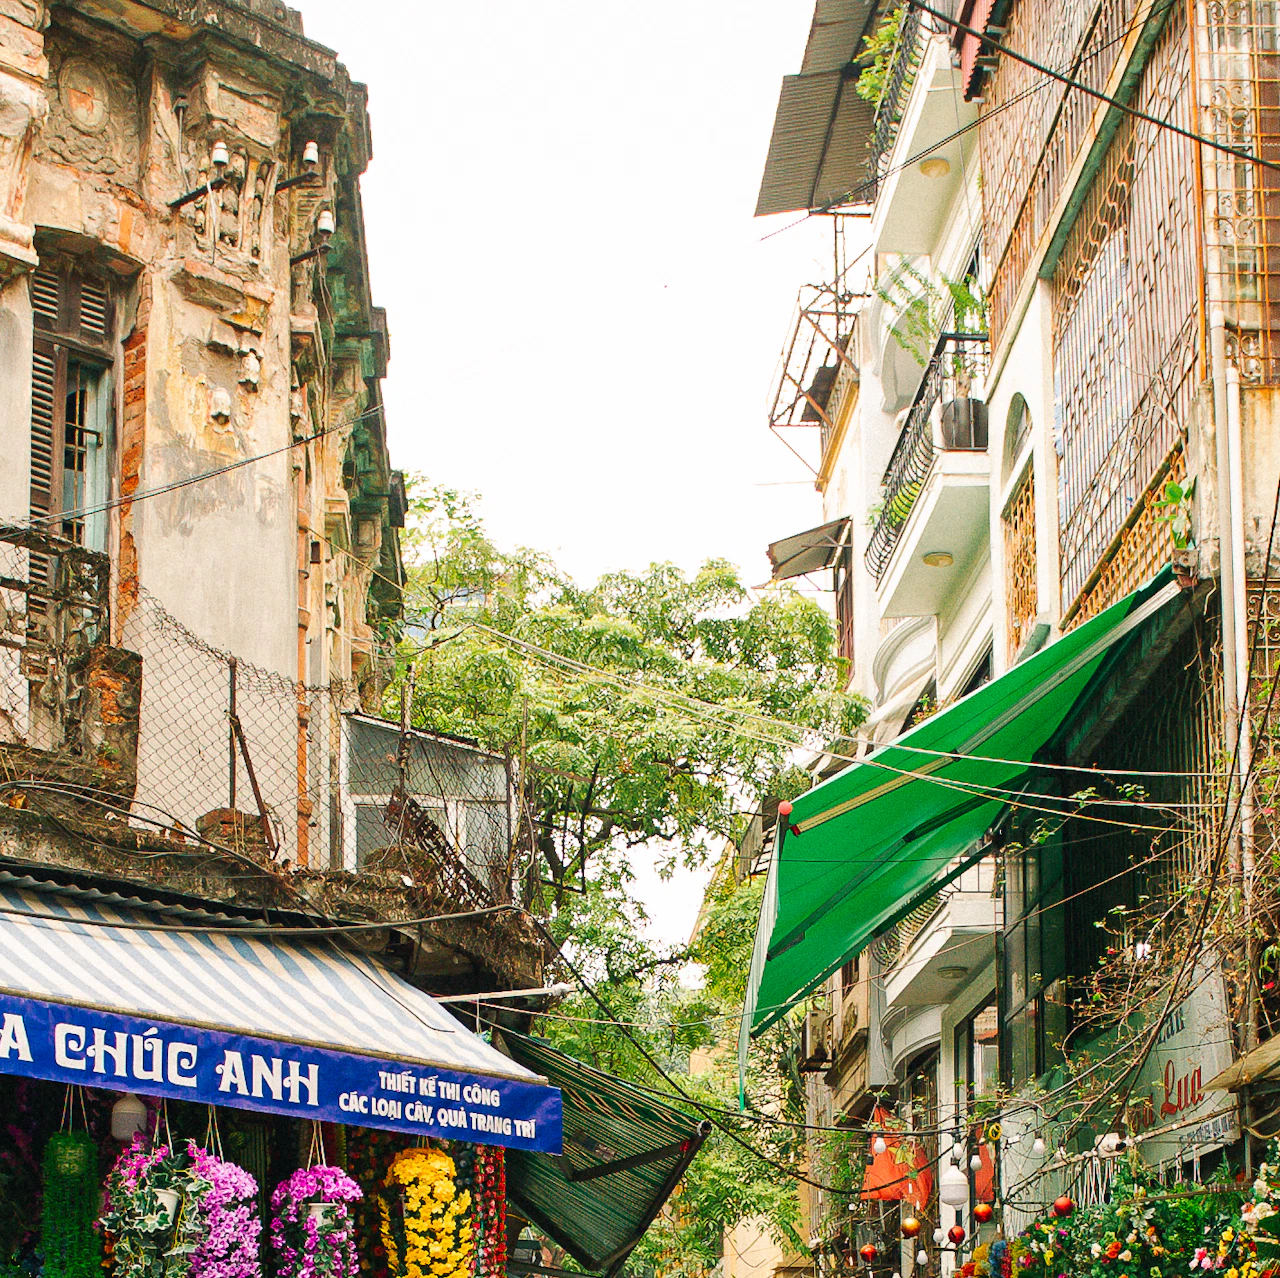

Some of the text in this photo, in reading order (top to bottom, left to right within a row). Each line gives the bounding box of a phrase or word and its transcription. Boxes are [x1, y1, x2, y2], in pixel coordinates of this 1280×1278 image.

[54, 1023, 198, 1088] CHÚC
[216, 1049, 320, 1106] ANH
[378, 1070, 500, 1107] THIẾT KẾ THI CÔNG
[338, 1091, 537, 1139] CÁC LOẠI CÂY, QUẢ TRANG TRÍ
